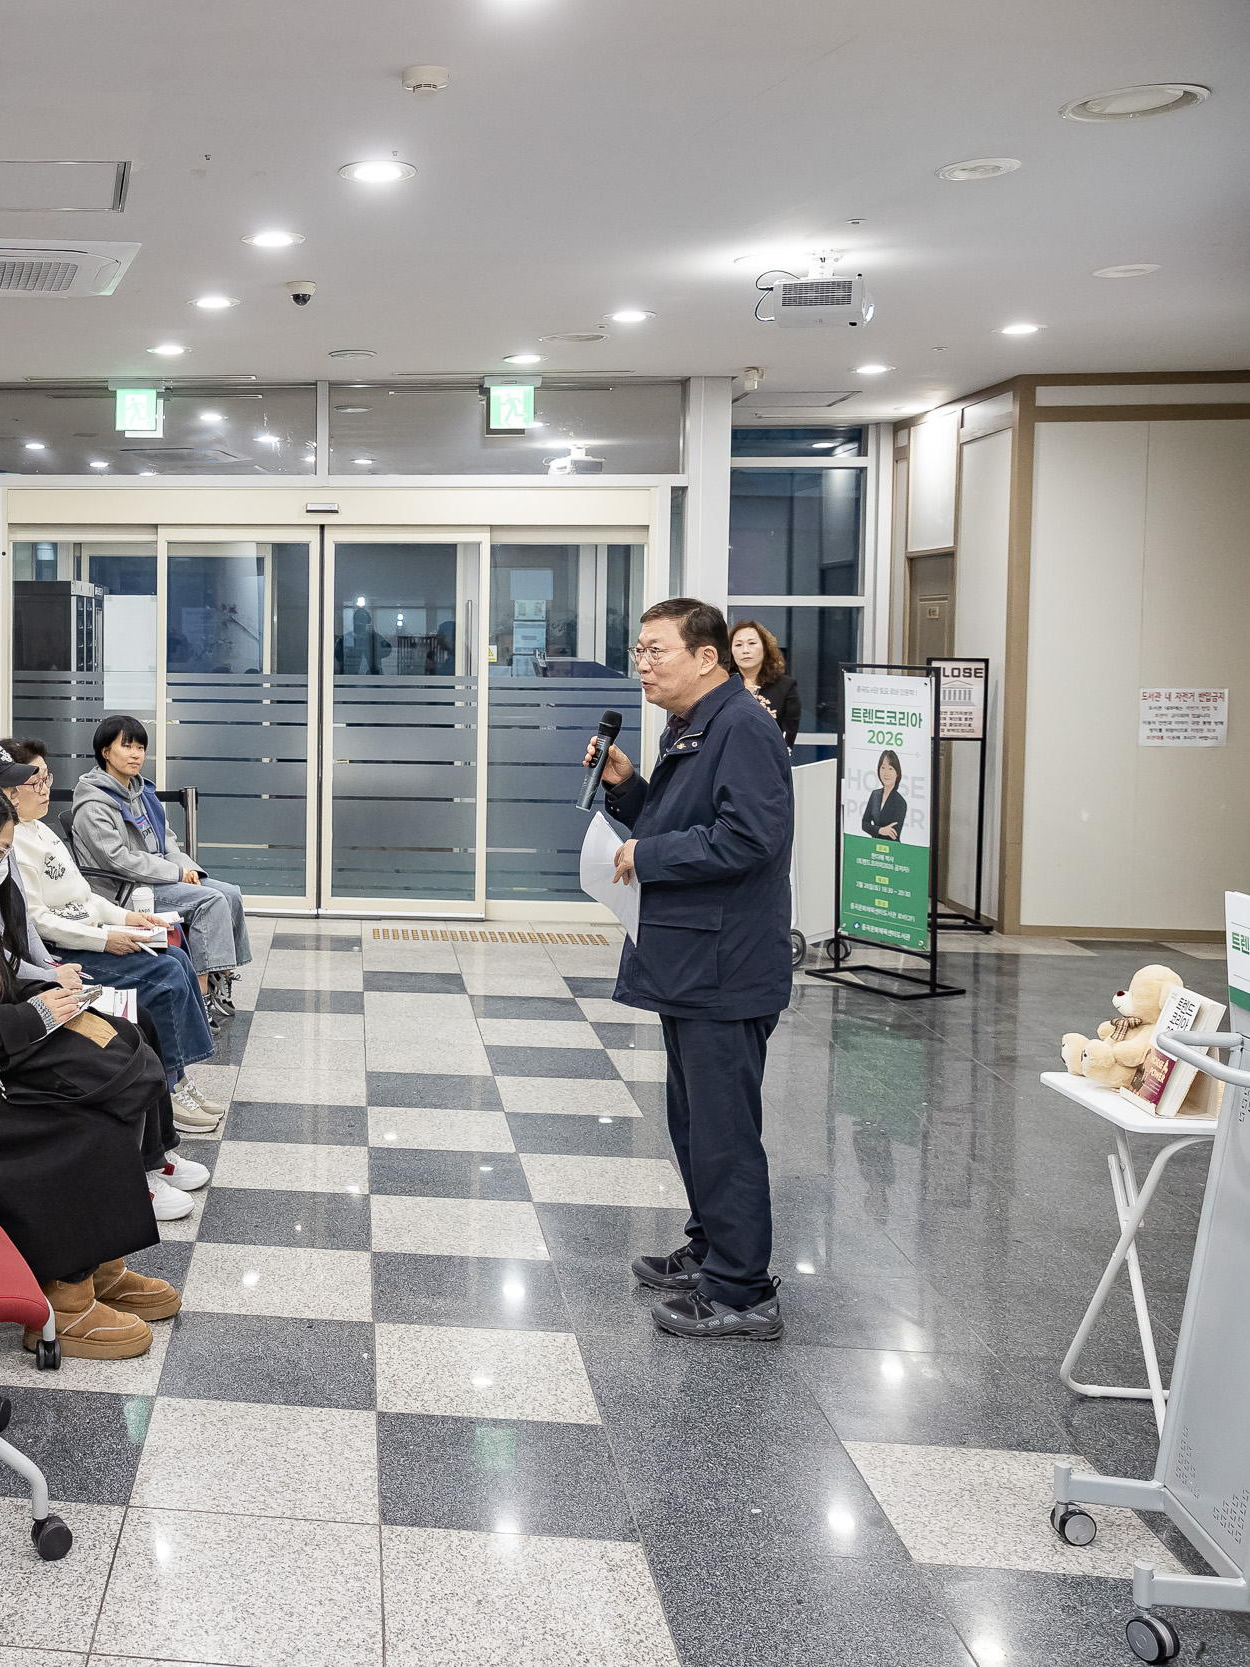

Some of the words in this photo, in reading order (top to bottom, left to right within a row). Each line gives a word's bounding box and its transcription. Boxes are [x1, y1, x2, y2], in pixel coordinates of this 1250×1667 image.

[943, 667, 984, 679] LOSE
[856, 686, 879, 695] 중곡도서관
[1141, 691, 1161, 702] 도서관
[1165, 691, 1172, 702] 내
[1174, 691, 1196, 702] 자전거
[1197, 691, 1226, 702] 반입금지
[851, 707, 923, 728] 트렌드코리아
[866, 729, 904, 746] 2026
[847, 767, 926, 800] HOSE
[1231, 931, 1250, 955] 트렌
